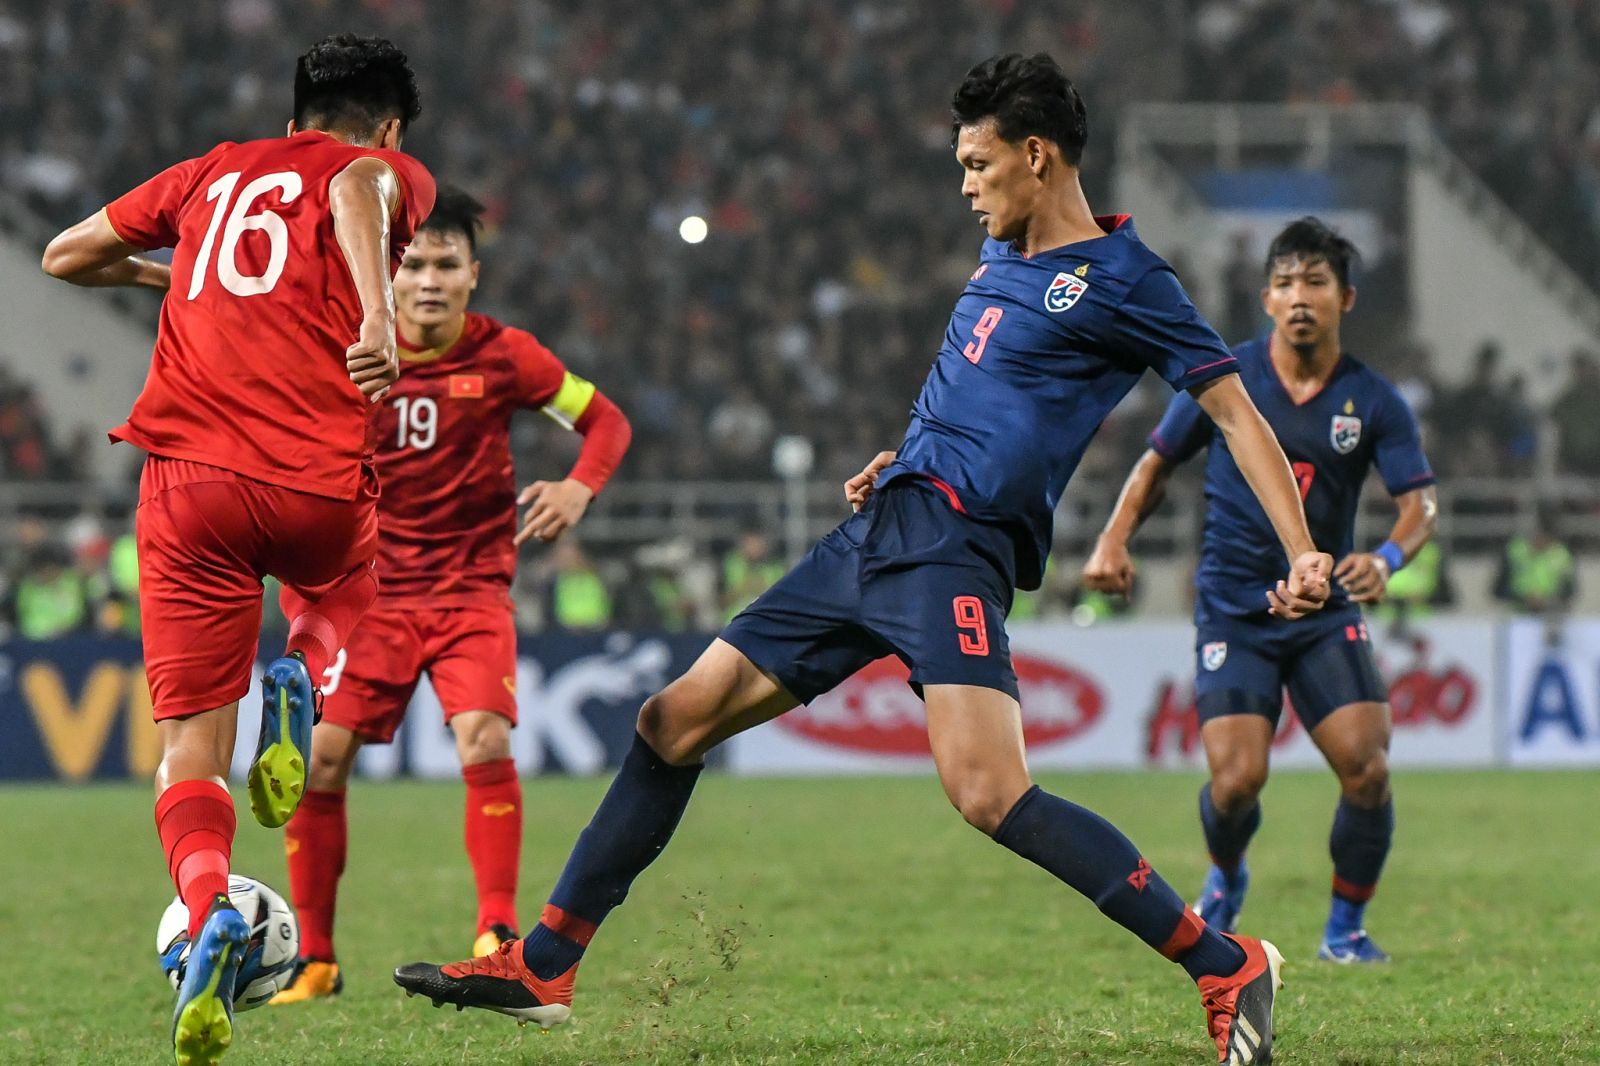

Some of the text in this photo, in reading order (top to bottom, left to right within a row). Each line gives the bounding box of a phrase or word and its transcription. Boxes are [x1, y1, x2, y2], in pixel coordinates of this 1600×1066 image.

[187, 170, 303, 301] 16
[963, 306, 1004, 365] 9
[393, 396, 438, 451] 19
[953, 595, 989, 657] 9
